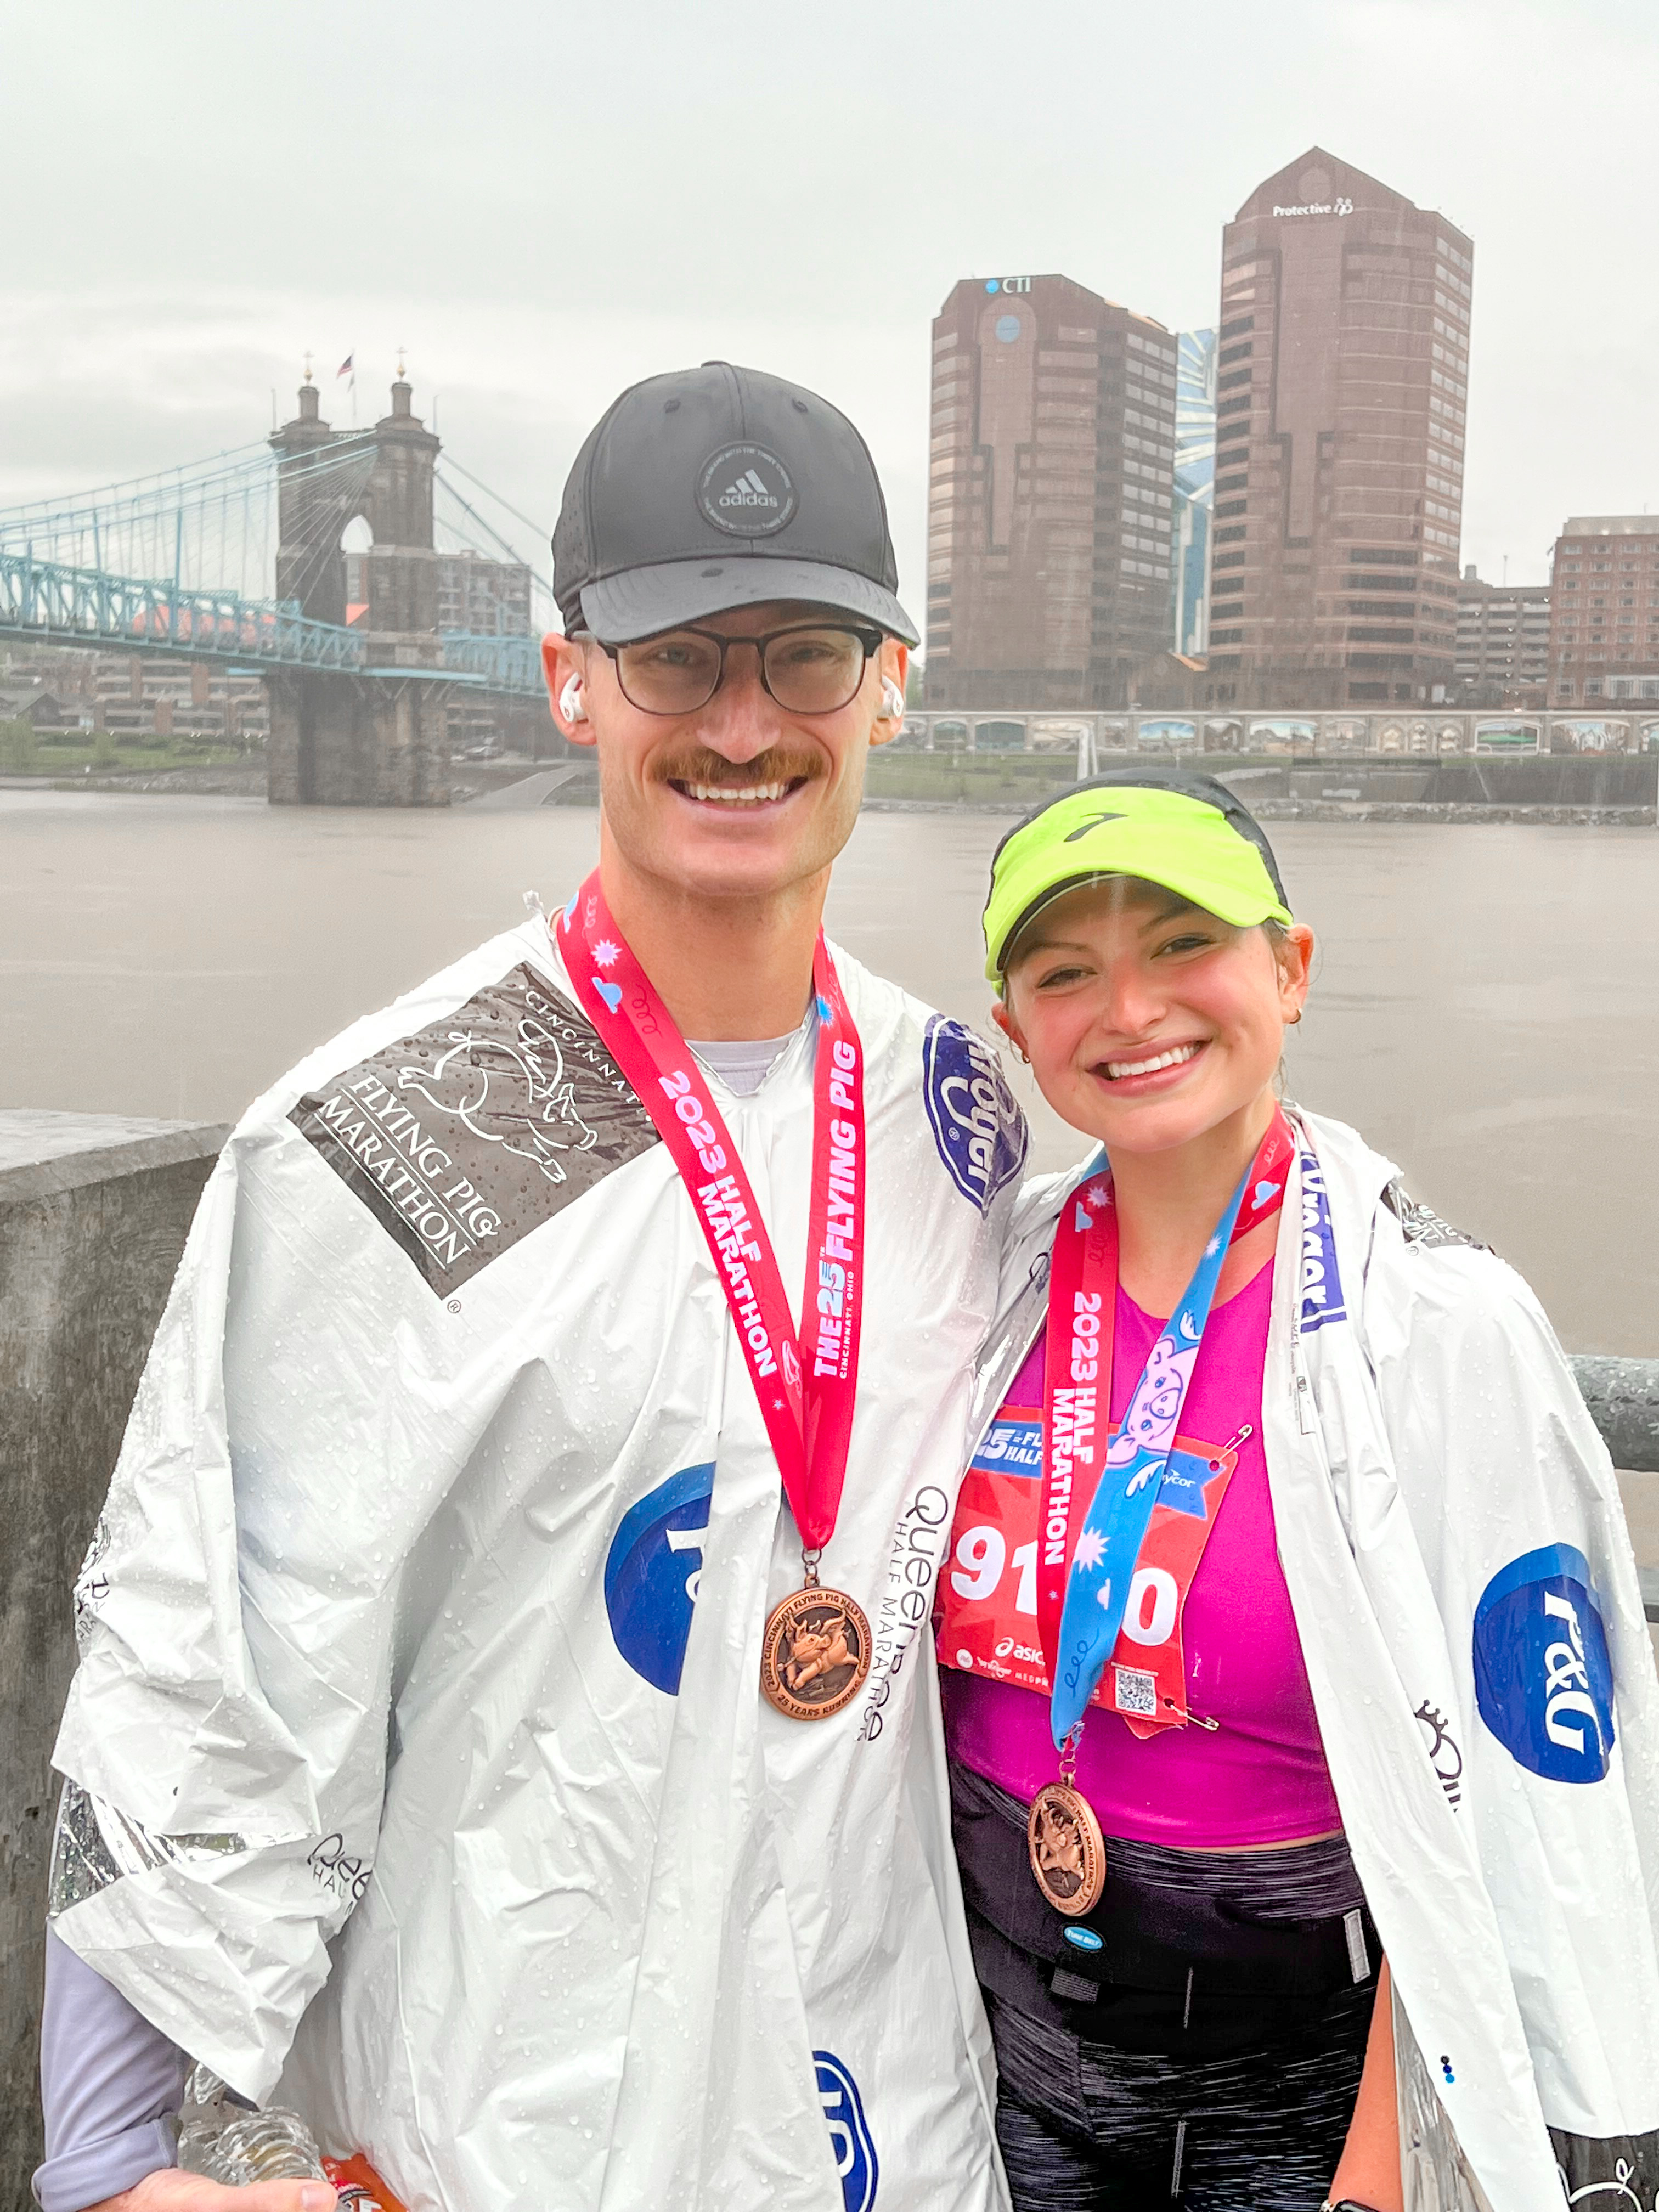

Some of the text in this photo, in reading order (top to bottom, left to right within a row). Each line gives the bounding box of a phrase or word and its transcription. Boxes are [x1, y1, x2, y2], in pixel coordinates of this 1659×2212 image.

[1273, 202, 1332, 217] Protective
[1002, 277, 1031, 293] CTI
[719, 493, 778, 508] adidas
[829, 1040, 856, 1111] PIG
[941, 1043, 1000, 1184] roger
[319, 1095, 471, 1264] MARATHON
[349, 1074, 502, 1238] FLYING PIG
[659, 1070, 763, 1262] 2023 HALF
[825, 1119, 857, 1262] FLYING
[697, 1182, 778, 1378] MARATHON
[847, 1271, 855, 1301] OHIO
[814, 1316, 843, 1378] THE
[1071, 1291, 1102, 1464] 2023 HALF
[1003, 1446, 1043, 1465] HALF
[1044, 1387, 1076, 1566] MARATHON
[888, 1521, 909, 1583] HALF
[764, 1663, 775, 1686] 2023
[793, 1593, 823, 1610] FLYING
[825, 1593, 839, 1602] PIG
[840, 1599, 860, 1615] HALF
[1013, 1644, 1046, 1666] asic
[789, 1703, 820, 1717] YEARS
